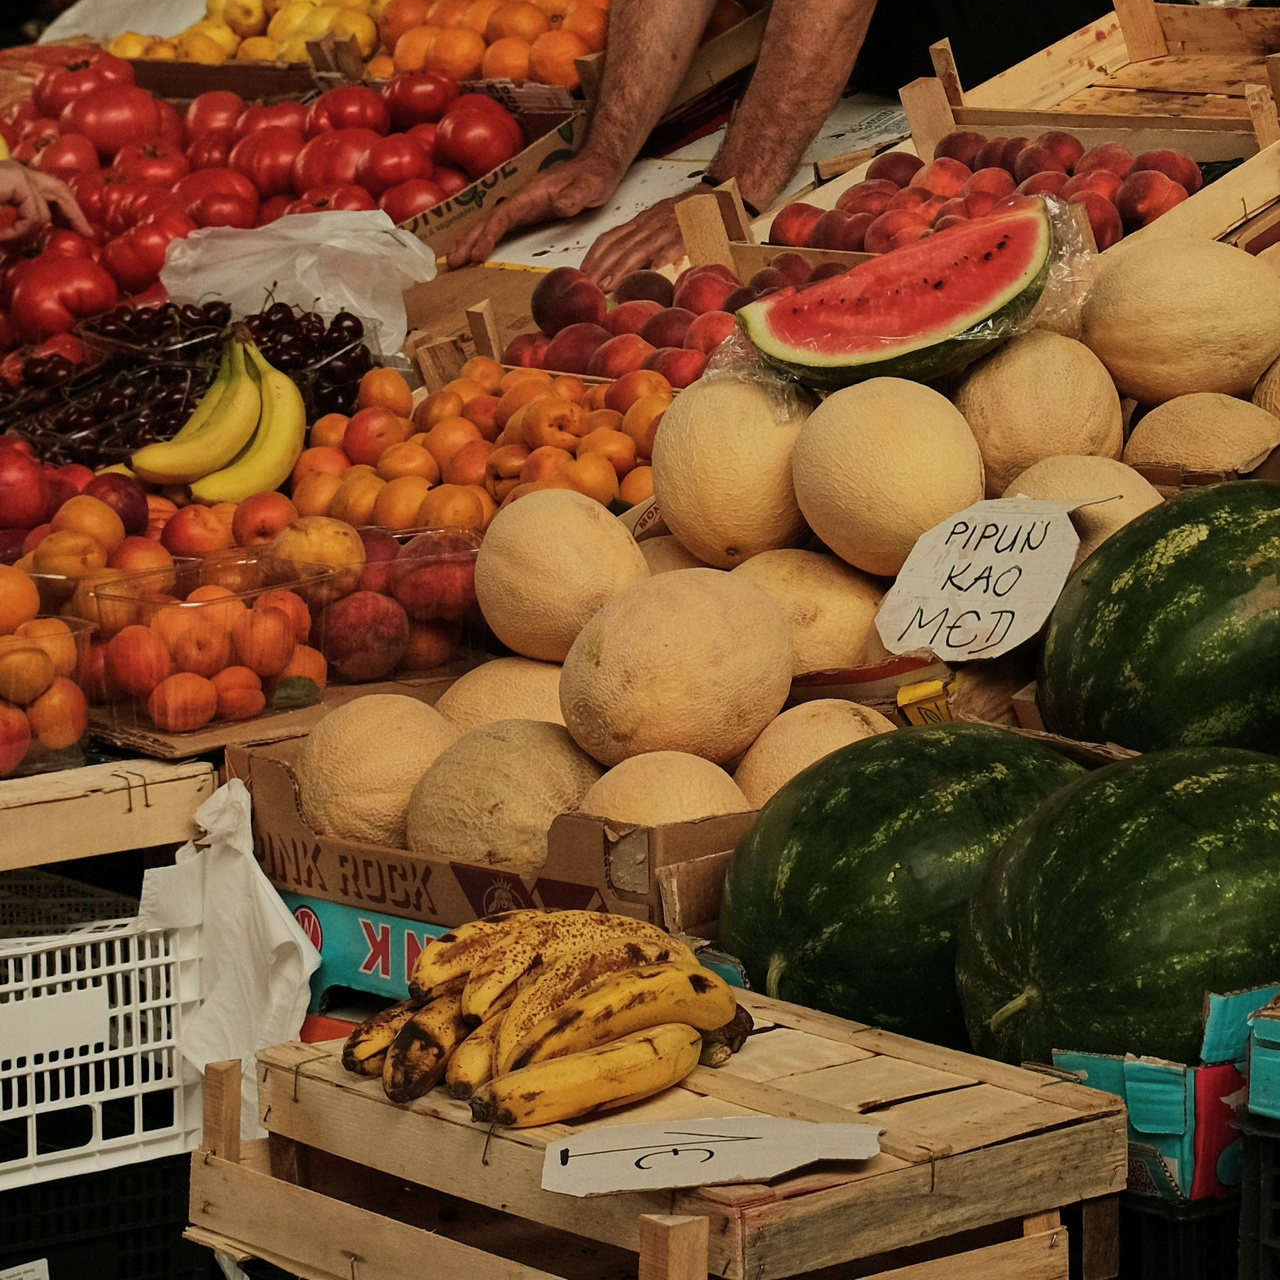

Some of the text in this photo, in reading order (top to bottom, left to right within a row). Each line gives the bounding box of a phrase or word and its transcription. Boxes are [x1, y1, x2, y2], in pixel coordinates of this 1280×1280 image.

[945, 521, 1052, 554] PIPUN
[940, 563, 1023, 598] KAO
[338, 854, 439, 916] ROCK
